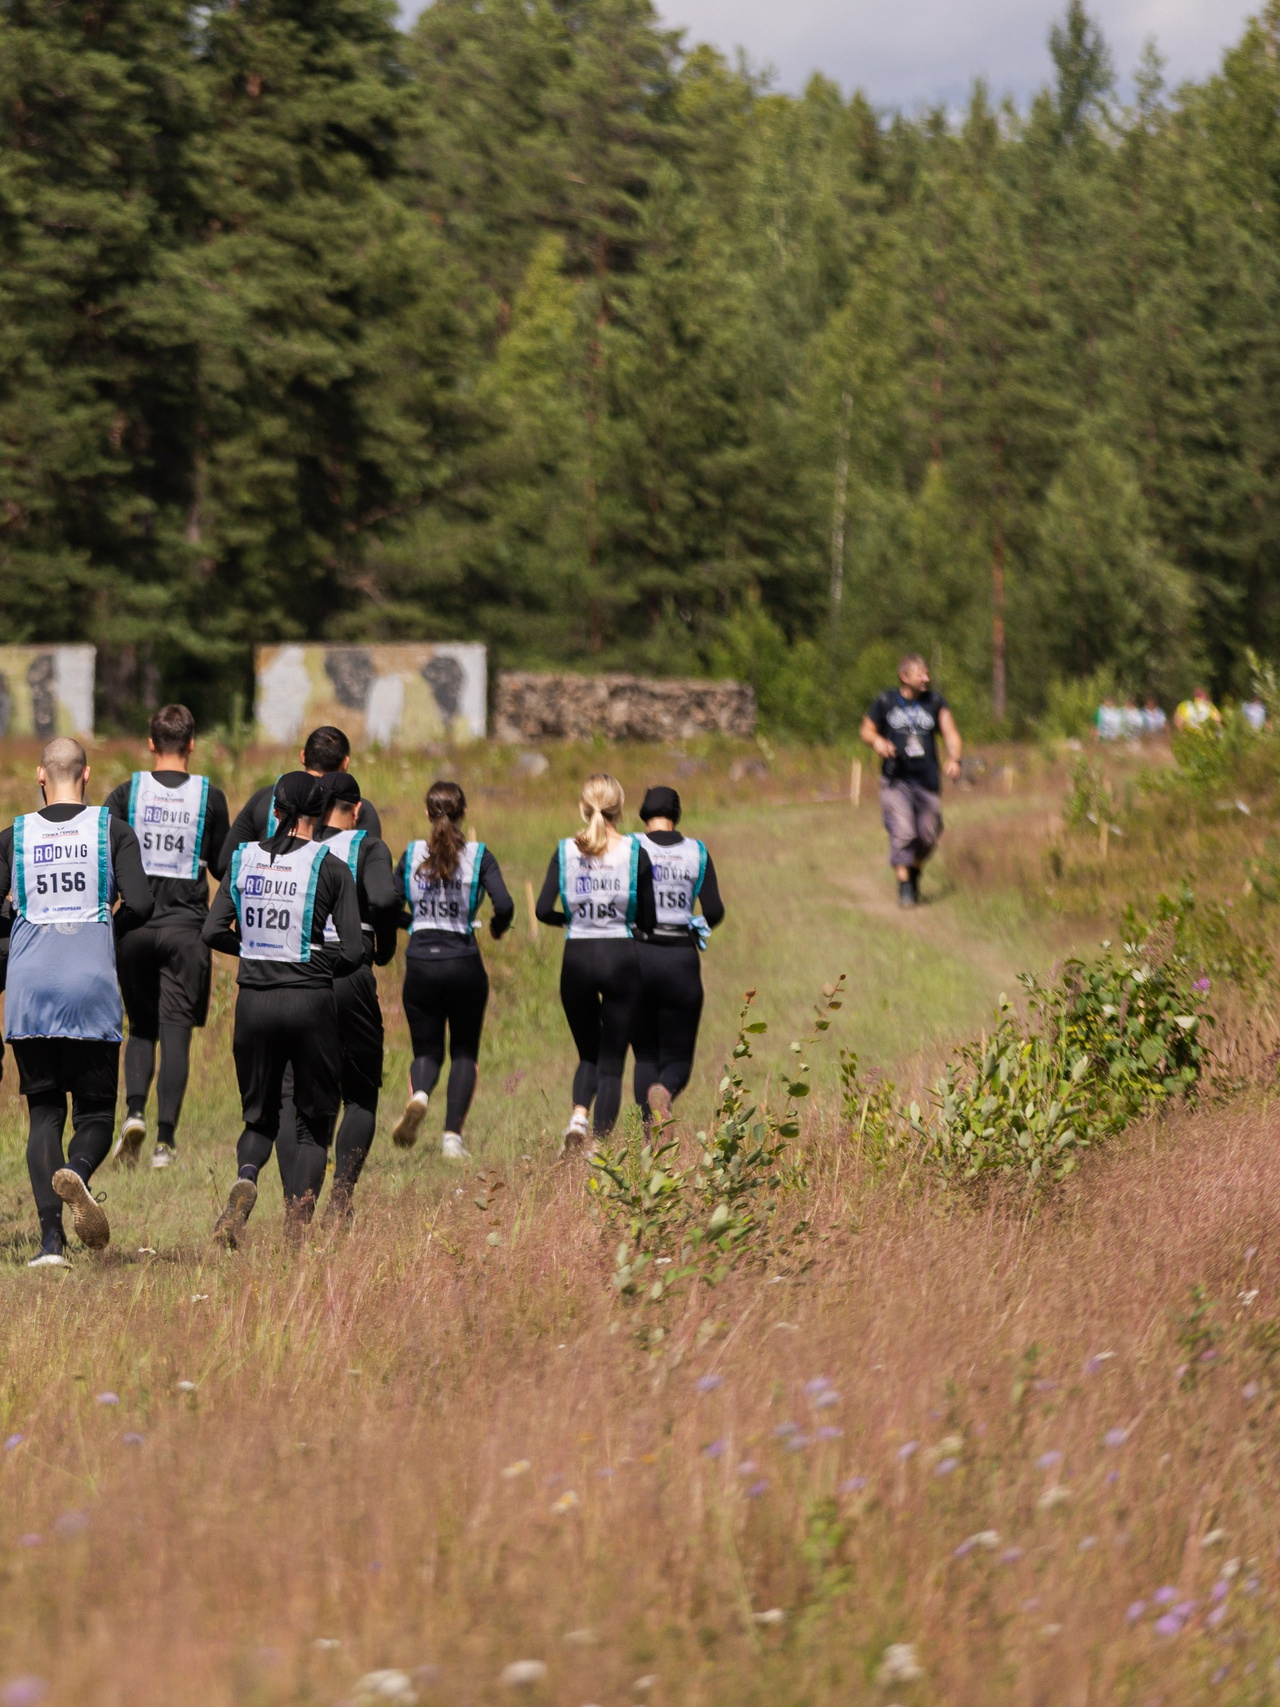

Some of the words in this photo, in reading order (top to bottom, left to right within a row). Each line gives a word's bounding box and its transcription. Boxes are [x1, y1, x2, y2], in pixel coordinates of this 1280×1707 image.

[145, 808, 191, 824] RODVIG
[143, 832, 185, 853] 5164
[34, 844, 88, 862] RODVIG
[653, 866, 691, 881] ODVIG
[36, 871, 86, 895] 5156
[245, 877, 297, 896] RODVIG
[576, 878, 621, 893] RODVIG
[419, 899, 460, 918] 5159
[658, 892, 687, 909] 158
[245, 906, 290, 930] 6120
[578, 903, 617, 919] 5165
